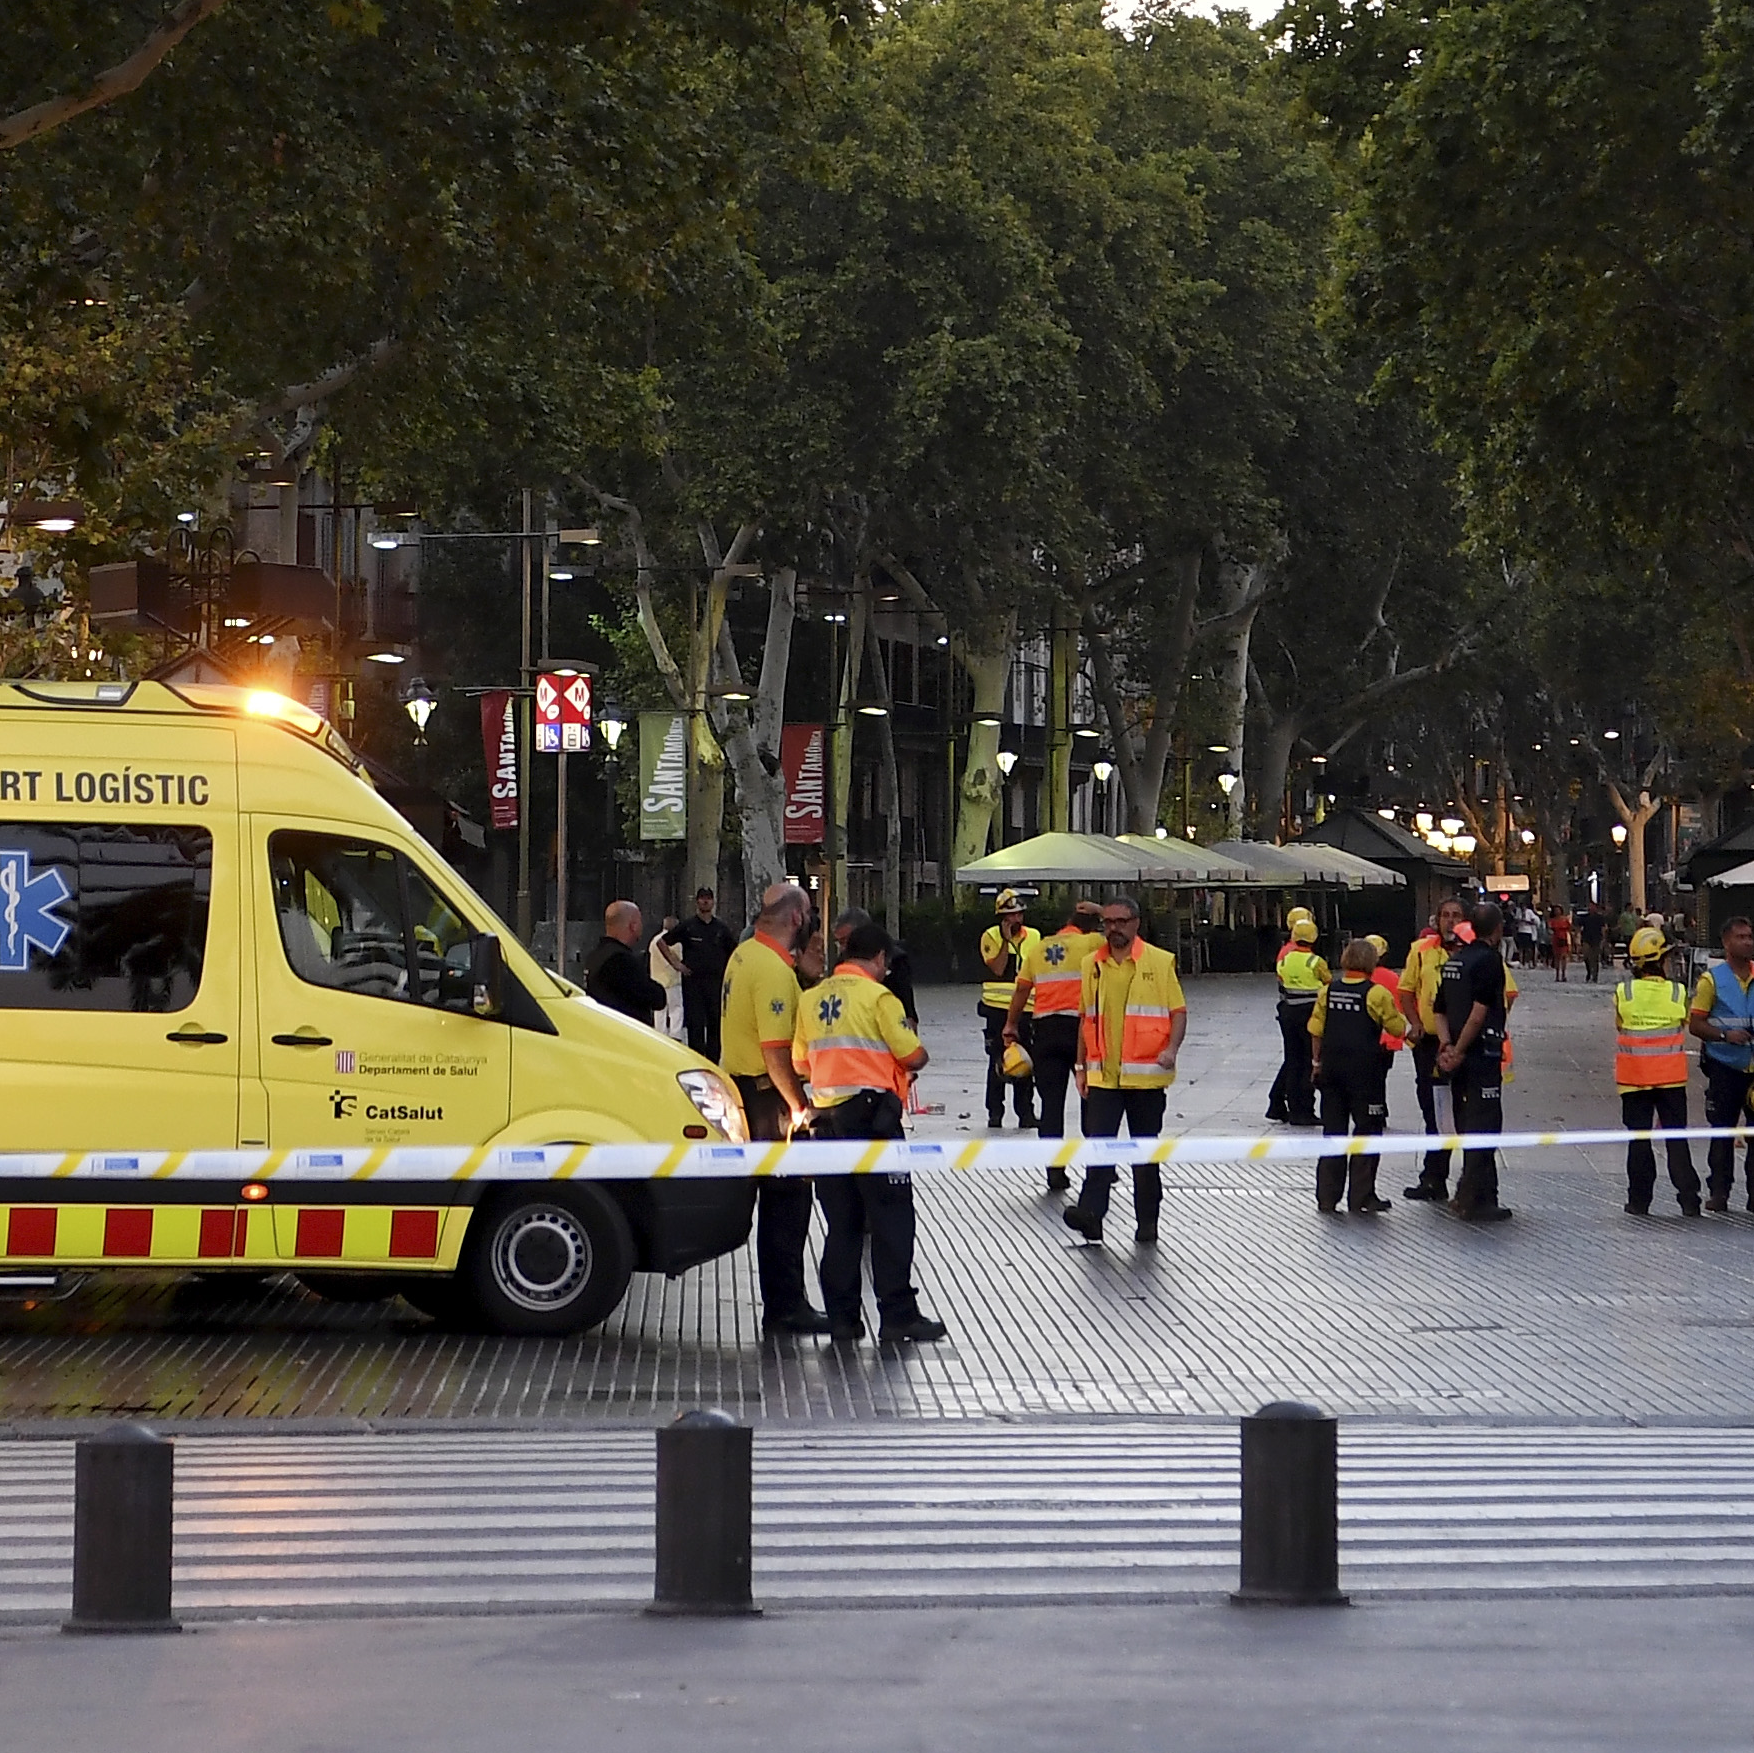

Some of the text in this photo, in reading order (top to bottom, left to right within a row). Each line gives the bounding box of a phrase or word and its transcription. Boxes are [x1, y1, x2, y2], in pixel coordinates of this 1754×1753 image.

[55, 766, 210, 806] LOGÍSTIC
[359, 1052, 488, 1066] Generalitat de Catalunya
[359, 1065, 478, 1076] Departament de Salut
[365, 1105, 444, 1120] CatSalut
